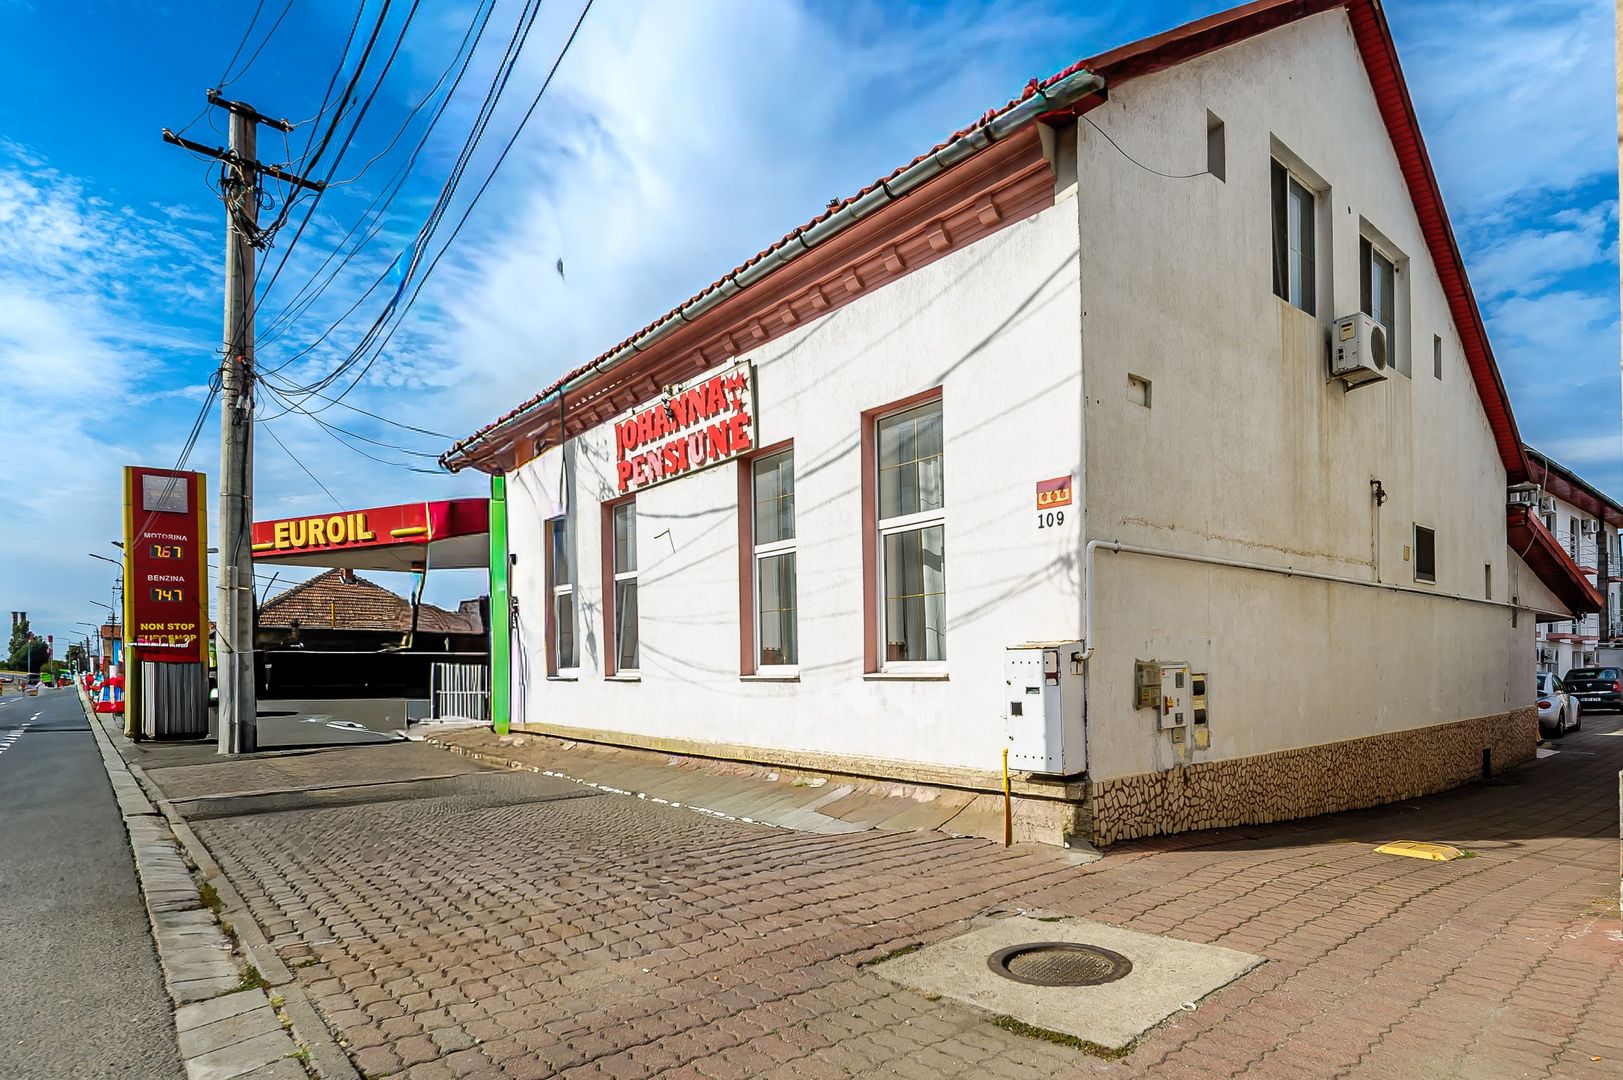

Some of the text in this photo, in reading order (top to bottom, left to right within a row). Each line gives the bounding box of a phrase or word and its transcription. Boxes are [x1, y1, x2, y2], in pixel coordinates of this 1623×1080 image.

[615, 375, 727, 460] JOHANNA
[617, 411, 752, 491] PENSIUNE
[1038, 511, 1065, 529] 109
[143, 532, 188, 542] MOTORINA
[273, 512, 375, 550] EUROIL
[147, 574, 185, 583] BENZINA
[140, 623, 195, 631] NON STOP
